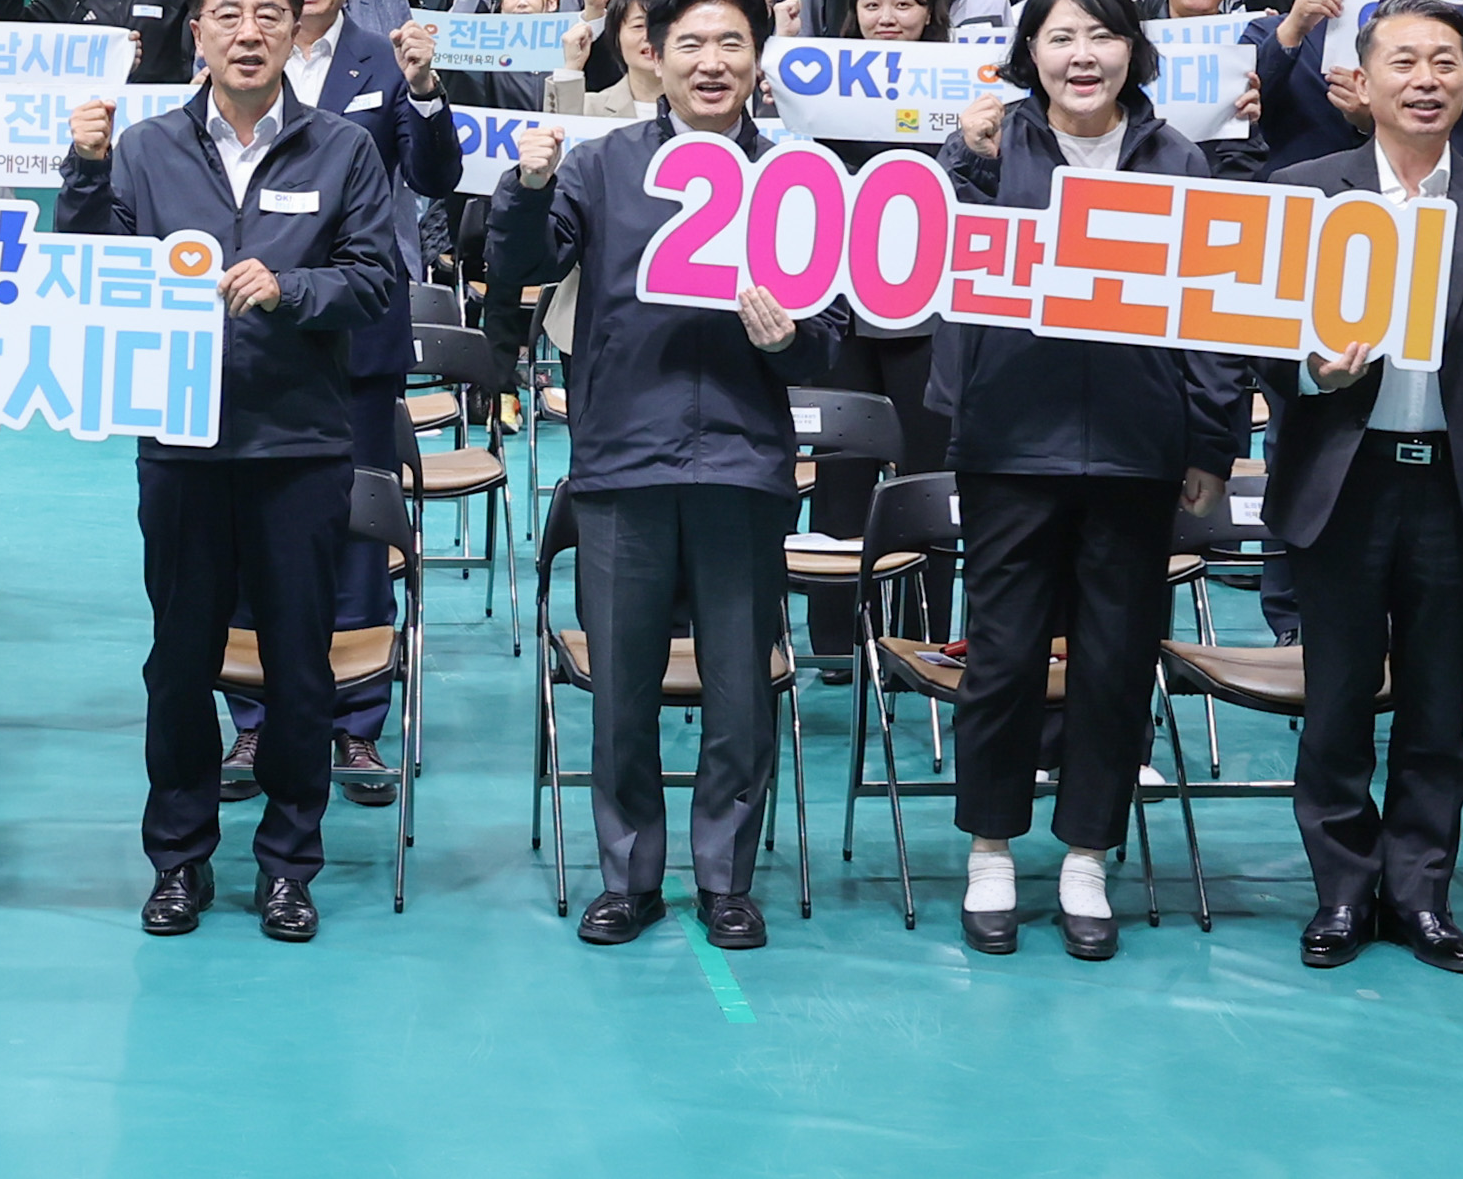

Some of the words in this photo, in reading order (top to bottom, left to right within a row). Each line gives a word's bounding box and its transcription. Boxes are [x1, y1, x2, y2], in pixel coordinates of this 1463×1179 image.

[432, 52, 495, 67] 장애인체육회
[448, 20, 567, 51] 전남시대
[778, 45, 904, 101] OK!
[908, 63, 1006, 101] 지금은
[35, 240, 218, 312] 지금은
[645, 140, 1045, 322] 200만
[1041, 174, 1450, 364] 도민이
